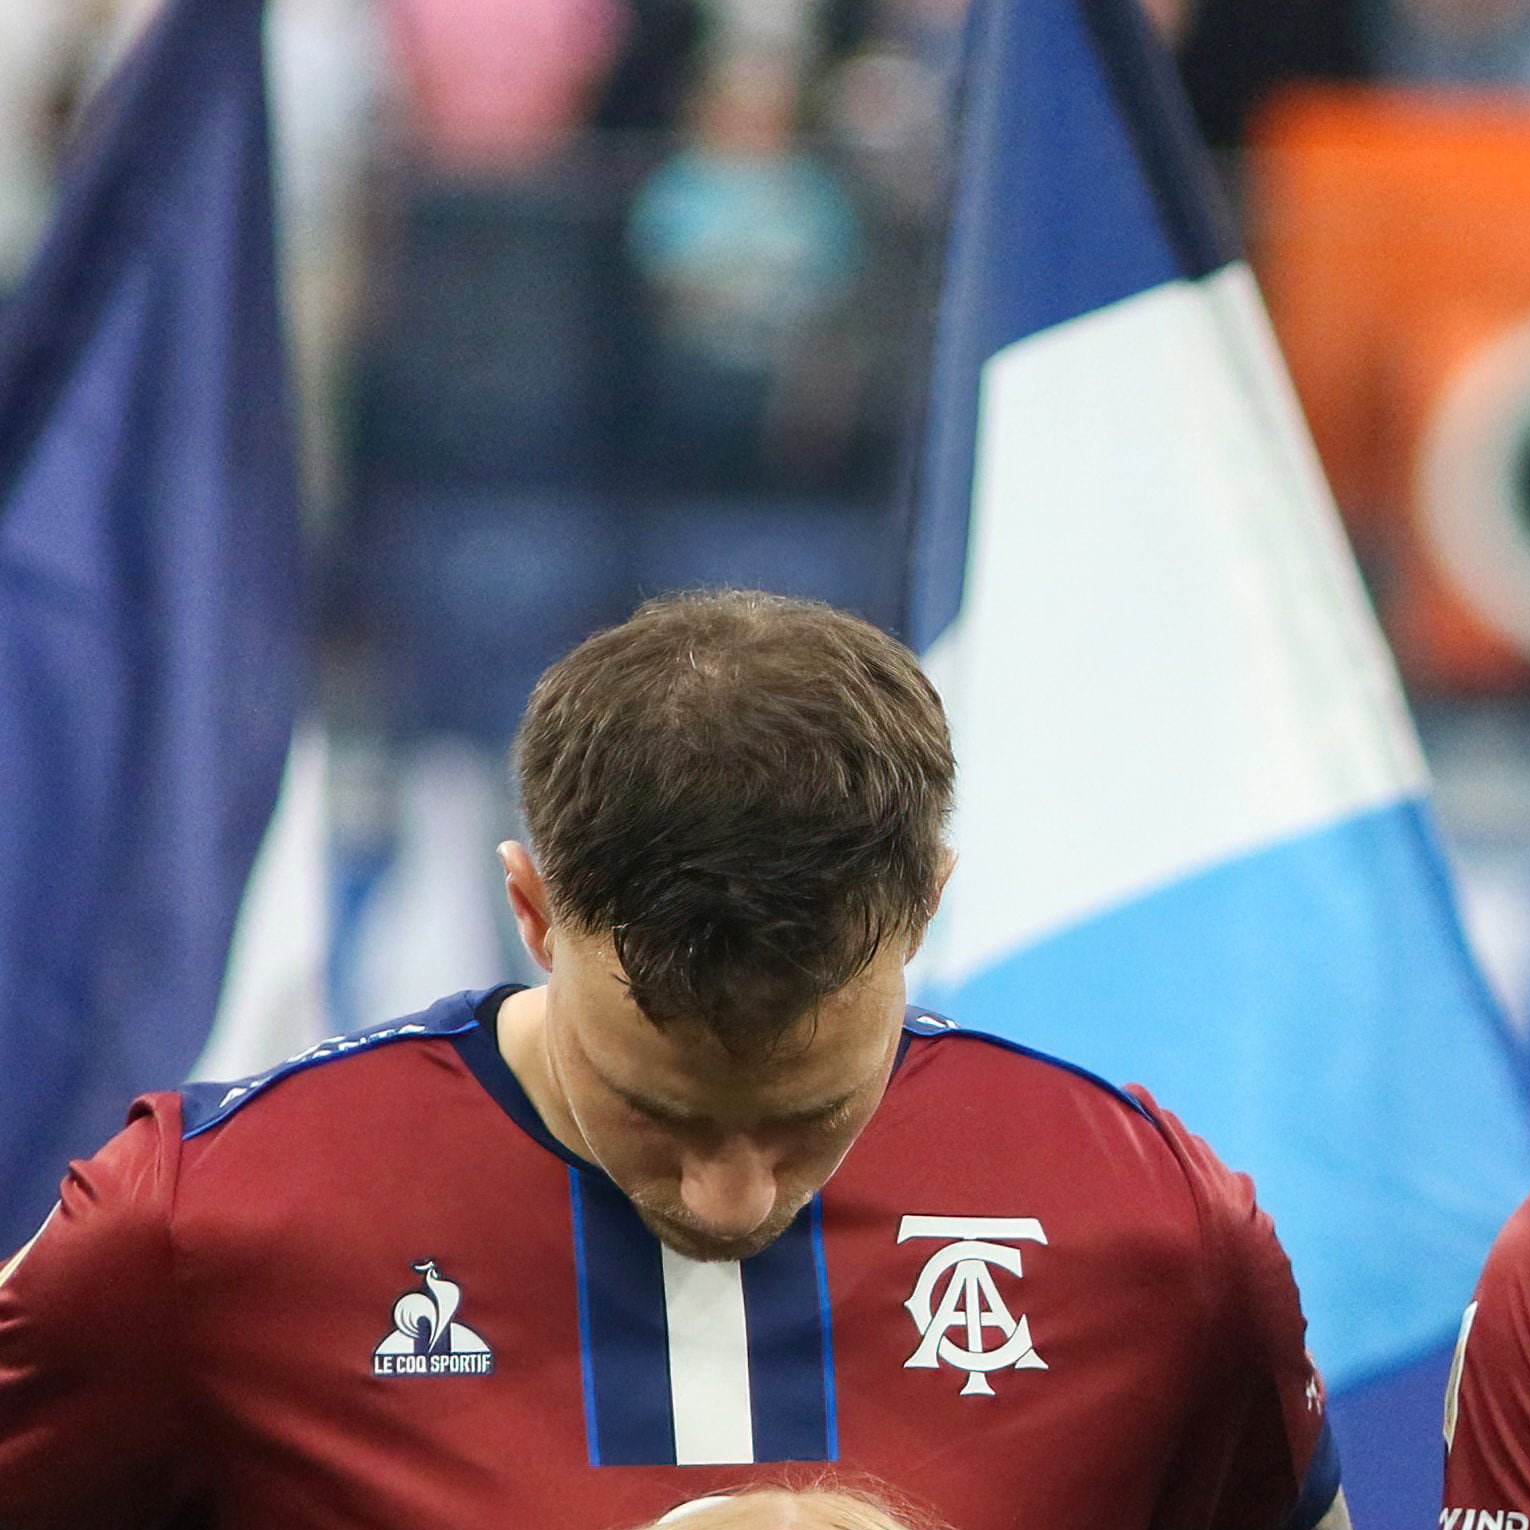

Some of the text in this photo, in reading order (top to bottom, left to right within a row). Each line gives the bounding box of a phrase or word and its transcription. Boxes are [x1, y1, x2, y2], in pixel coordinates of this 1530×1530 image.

[374, 1353, 492, 1374] LE COQ SPORTIF
